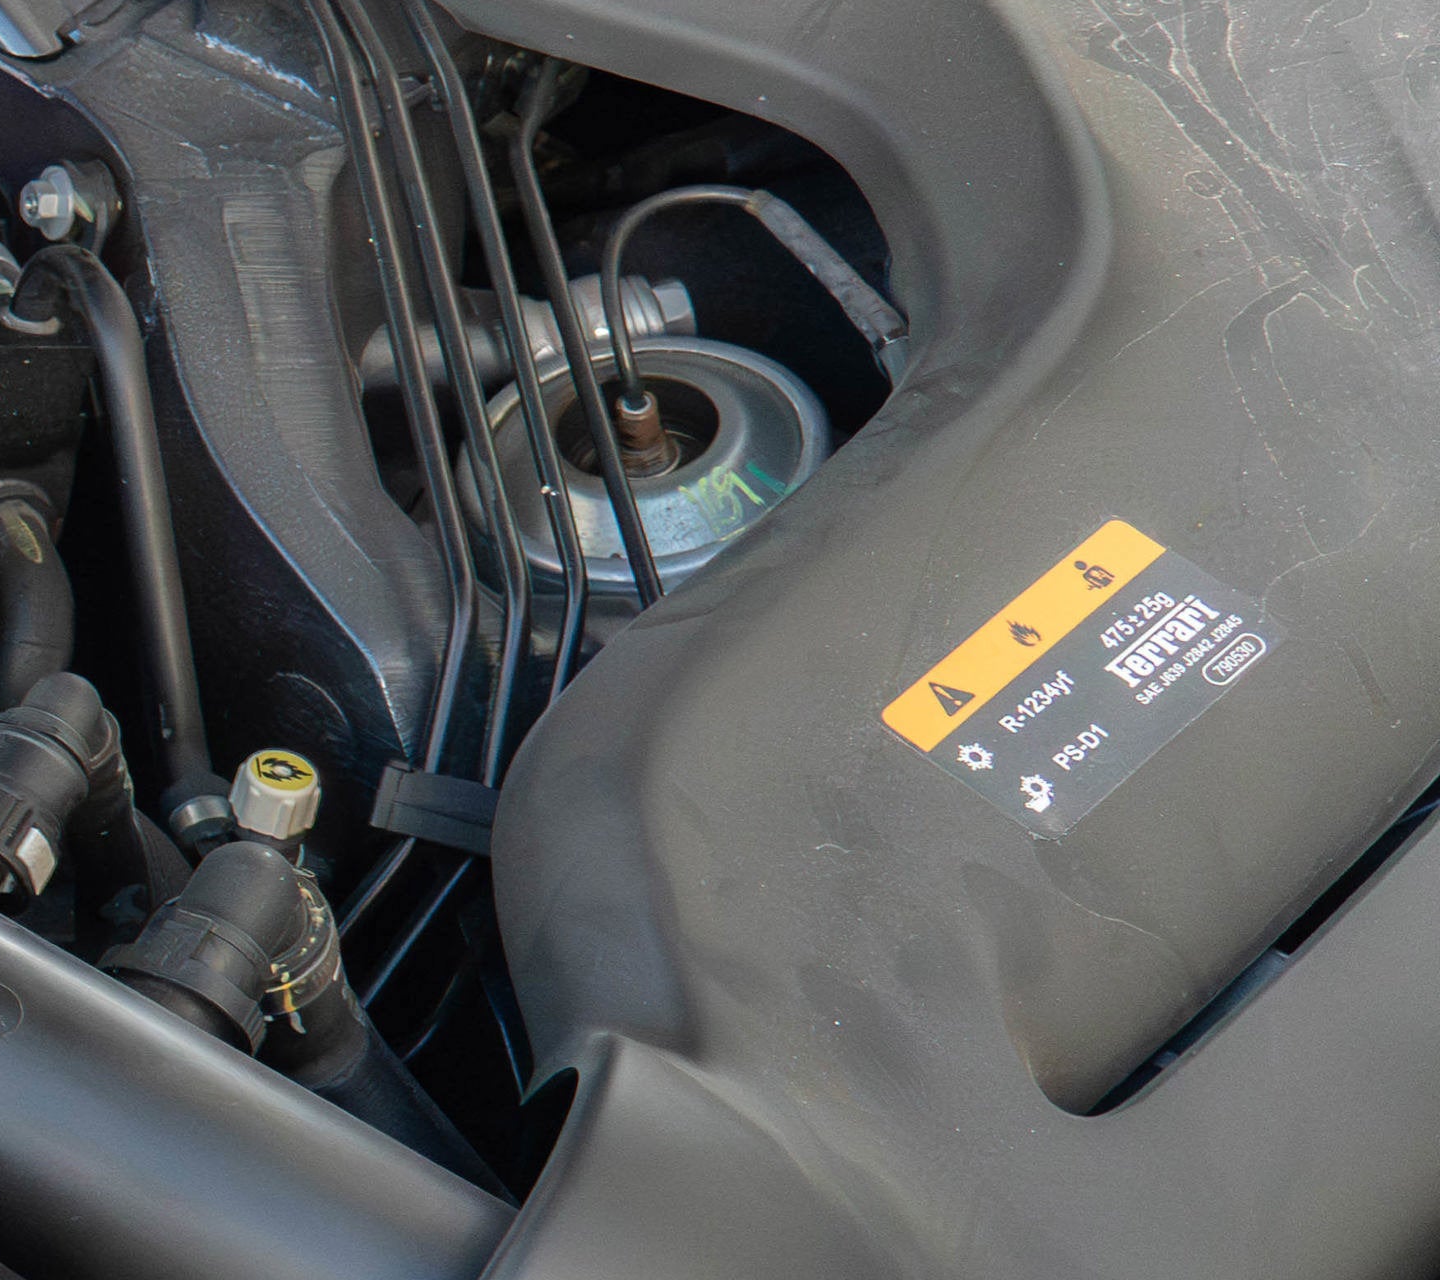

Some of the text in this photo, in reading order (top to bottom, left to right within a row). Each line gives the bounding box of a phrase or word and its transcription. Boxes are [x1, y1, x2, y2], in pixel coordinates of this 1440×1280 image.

[1104, 595, 1220, 688] Ferrari
[1135, 614, 1243, 705] SAE J639 J2842 J2845
[1212, 641, 1255, 677] 790530
[999, 670, 1075, 733] R-1234yf
[1052, 723, 1109, 770] PS-D1
